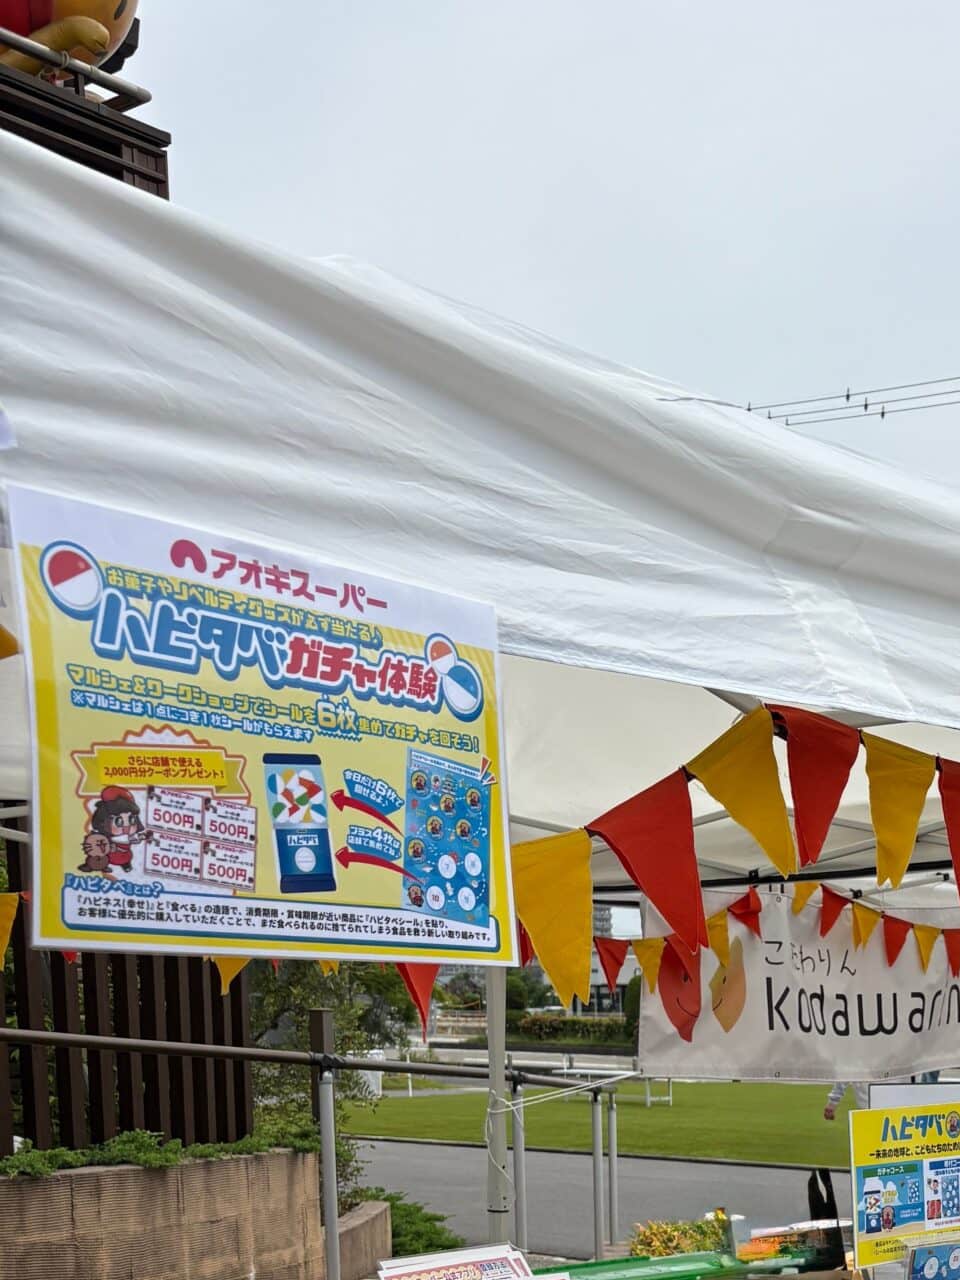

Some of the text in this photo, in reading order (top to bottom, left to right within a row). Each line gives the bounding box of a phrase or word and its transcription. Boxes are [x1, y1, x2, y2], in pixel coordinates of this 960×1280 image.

[211, 548, 388, 613] アオキスーパー
[152, 808, 194, 829] 500円
[209, 821, 248, 840] 500円
[151, 855, 193, 873] 500円
[207, 864, 247, 882] 500円
